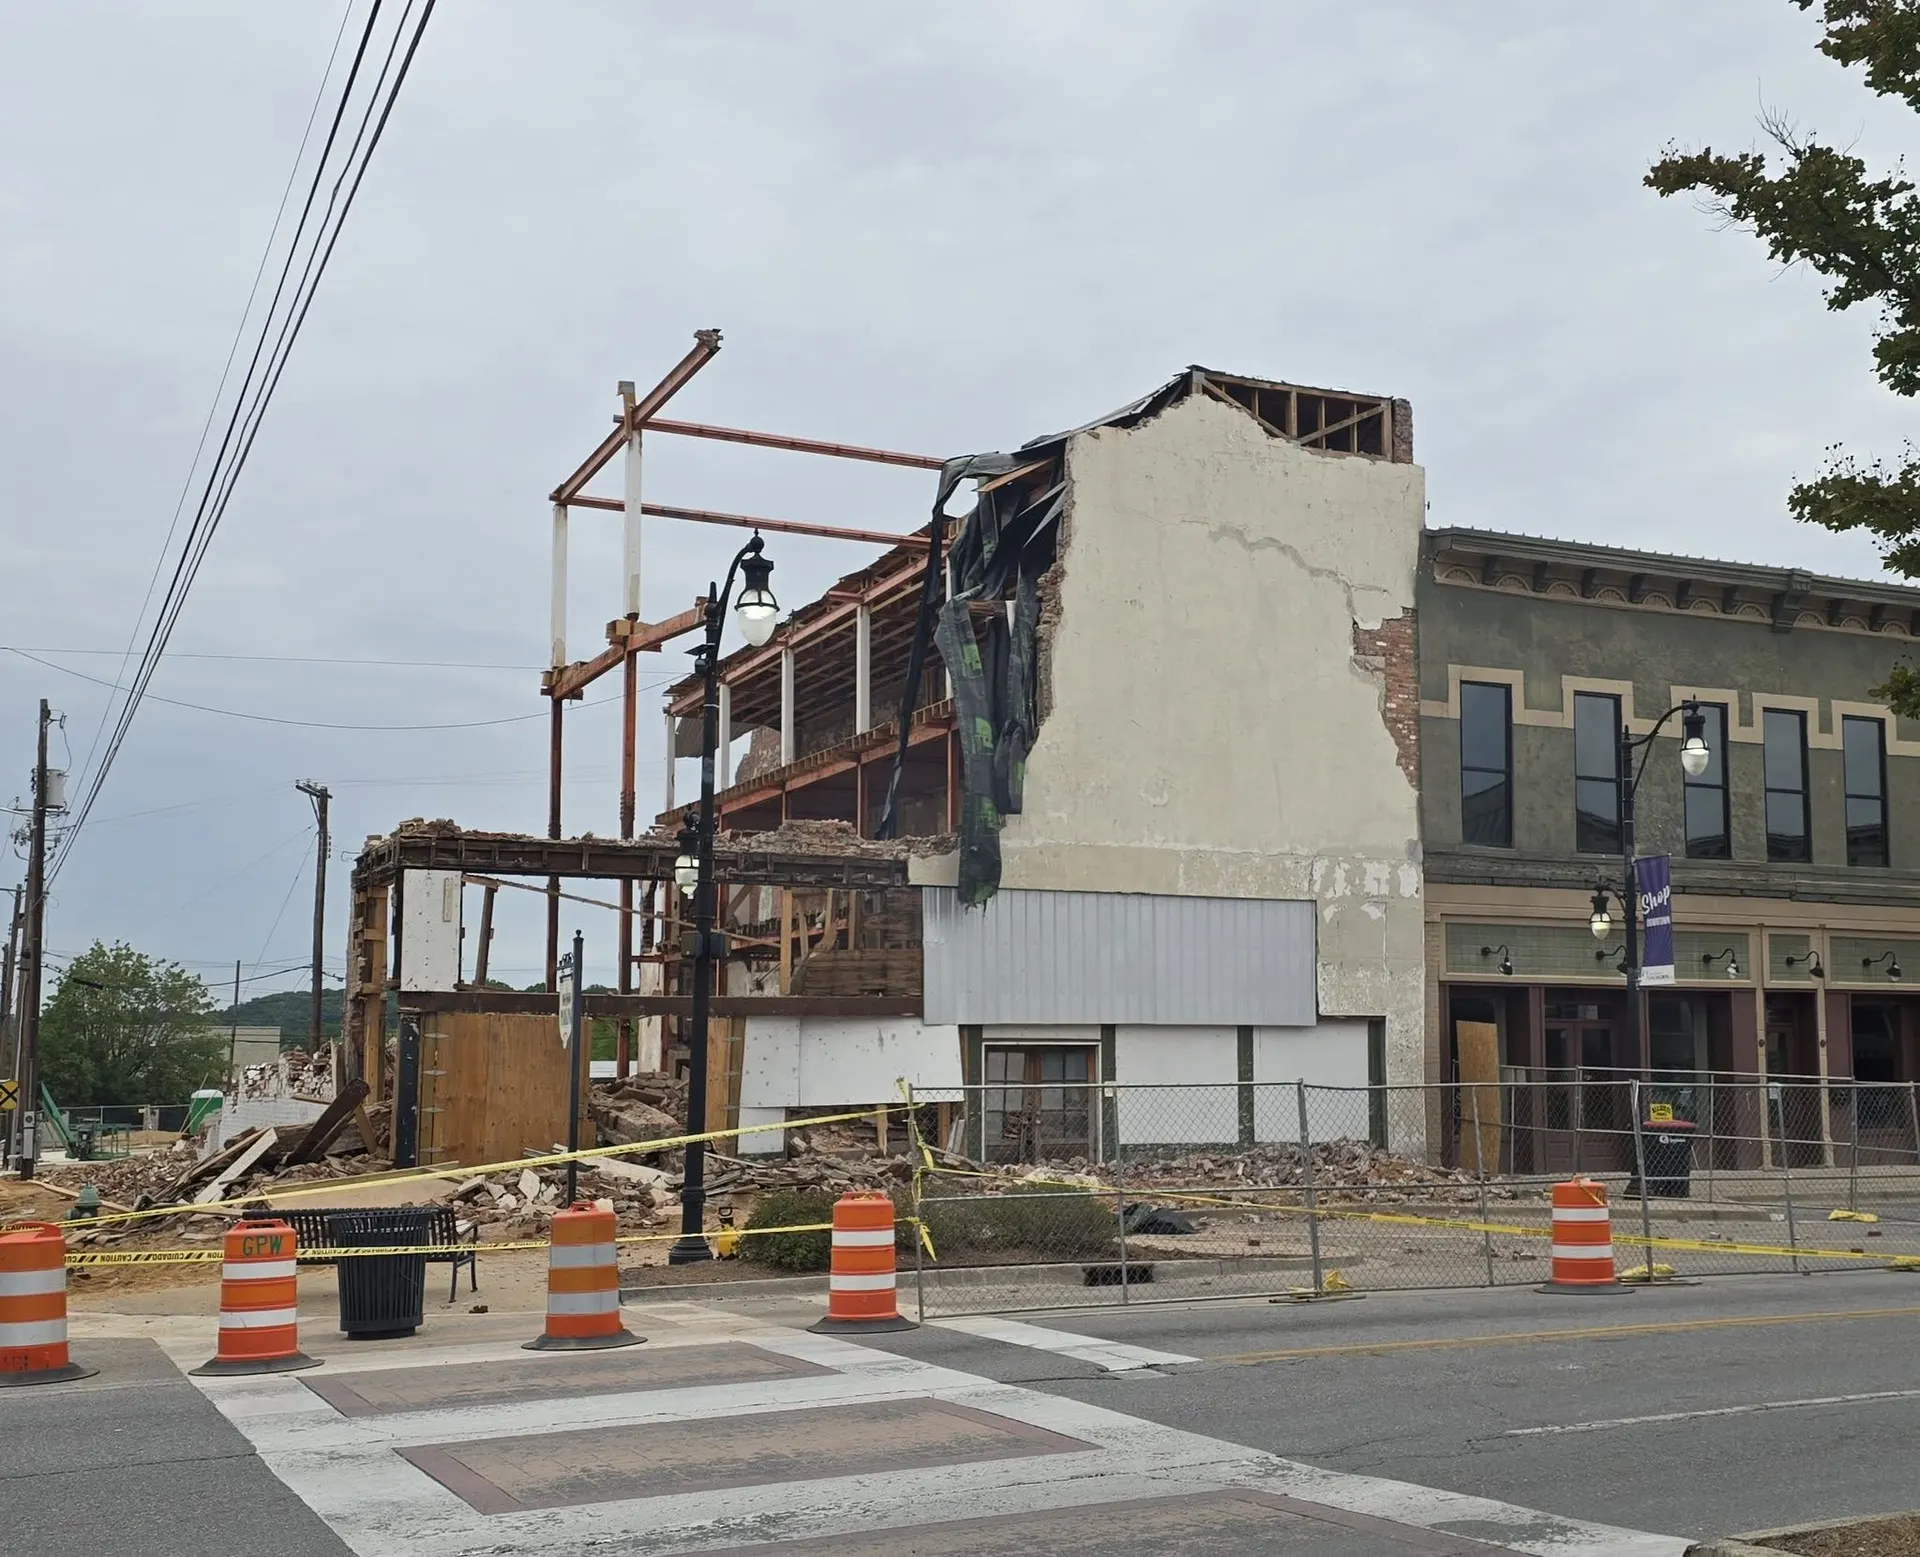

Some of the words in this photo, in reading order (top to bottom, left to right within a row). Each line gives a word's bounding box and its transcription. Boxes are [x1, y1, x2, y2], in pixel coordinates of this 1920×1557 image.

[1641, 885, 1671, 915] Shop
[242, 1235, 283, 1257] GPW
[100, 1254, 133, 1262] CAUTION
[151, 1252, 185, 1261] CUIDADO
